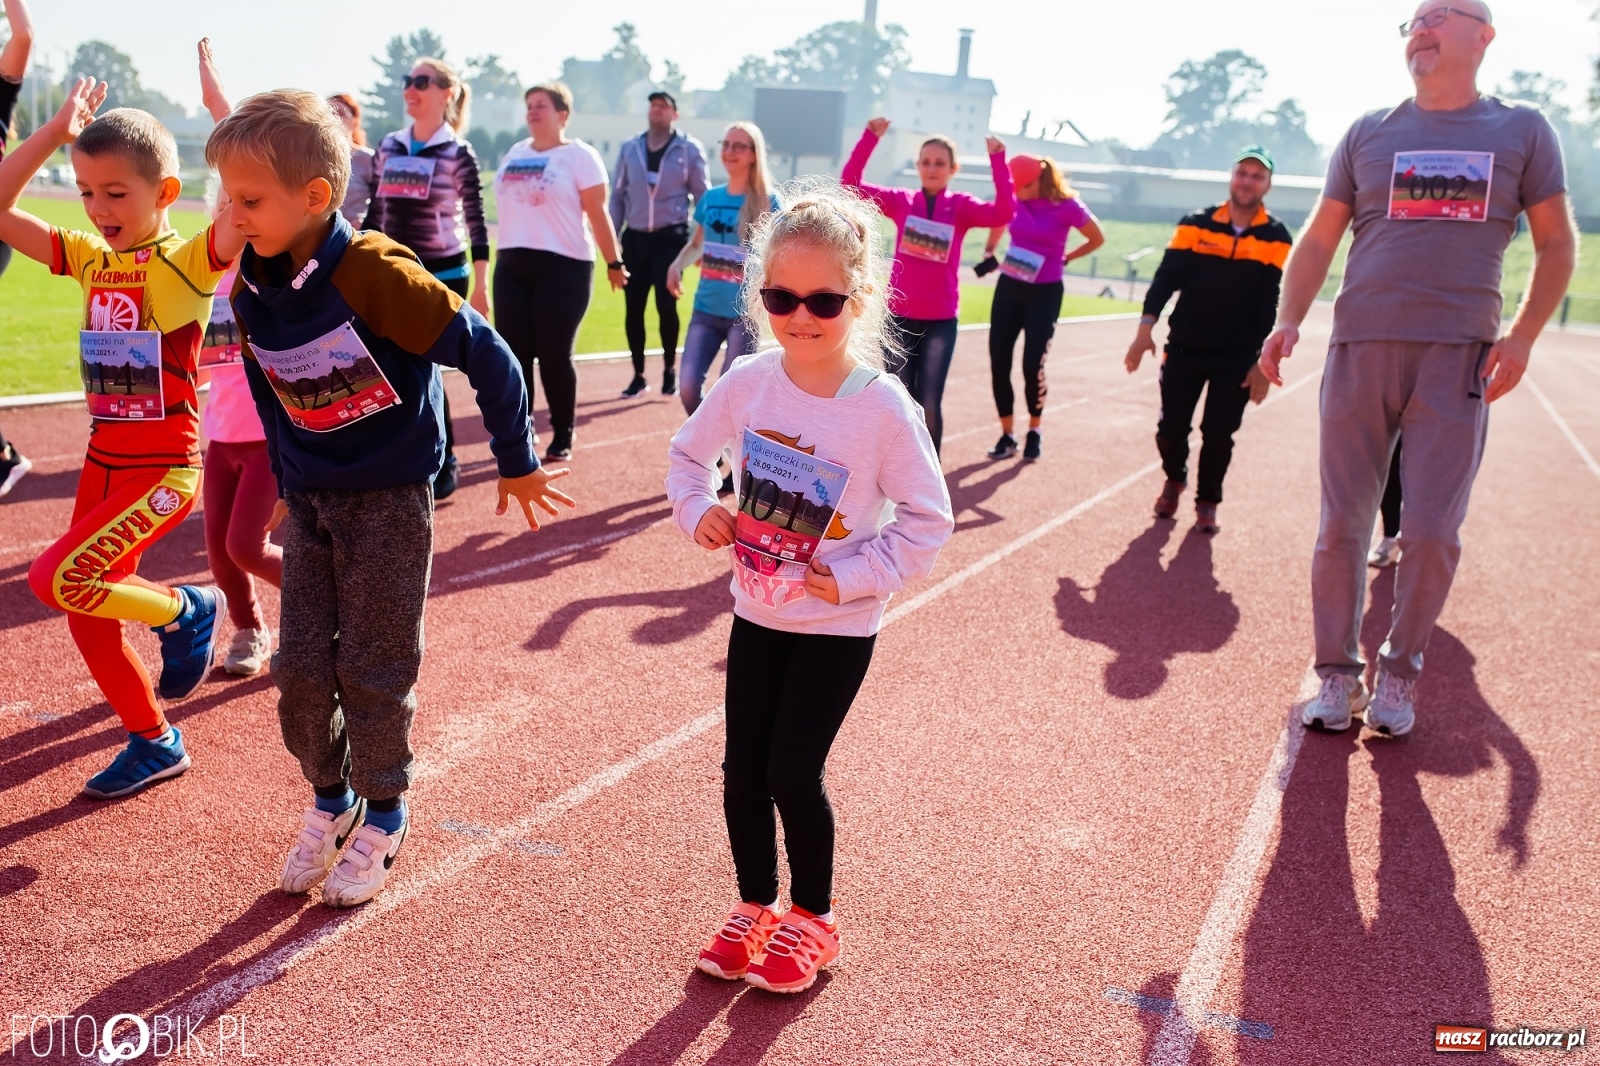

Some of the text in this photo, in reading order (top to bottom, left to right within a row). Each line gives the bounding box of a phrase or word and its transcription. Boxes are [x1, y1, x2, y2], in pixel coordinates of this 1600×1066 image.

[1410, 174, 1467, 201] 002
[114, 338, 125, 346] na
[307, 347, 320, 356] na
[280, 366, 360, 410] 024
[753, 459, 800, 482] 26.09.2021 r.
[800, 461, 814, 473] na
